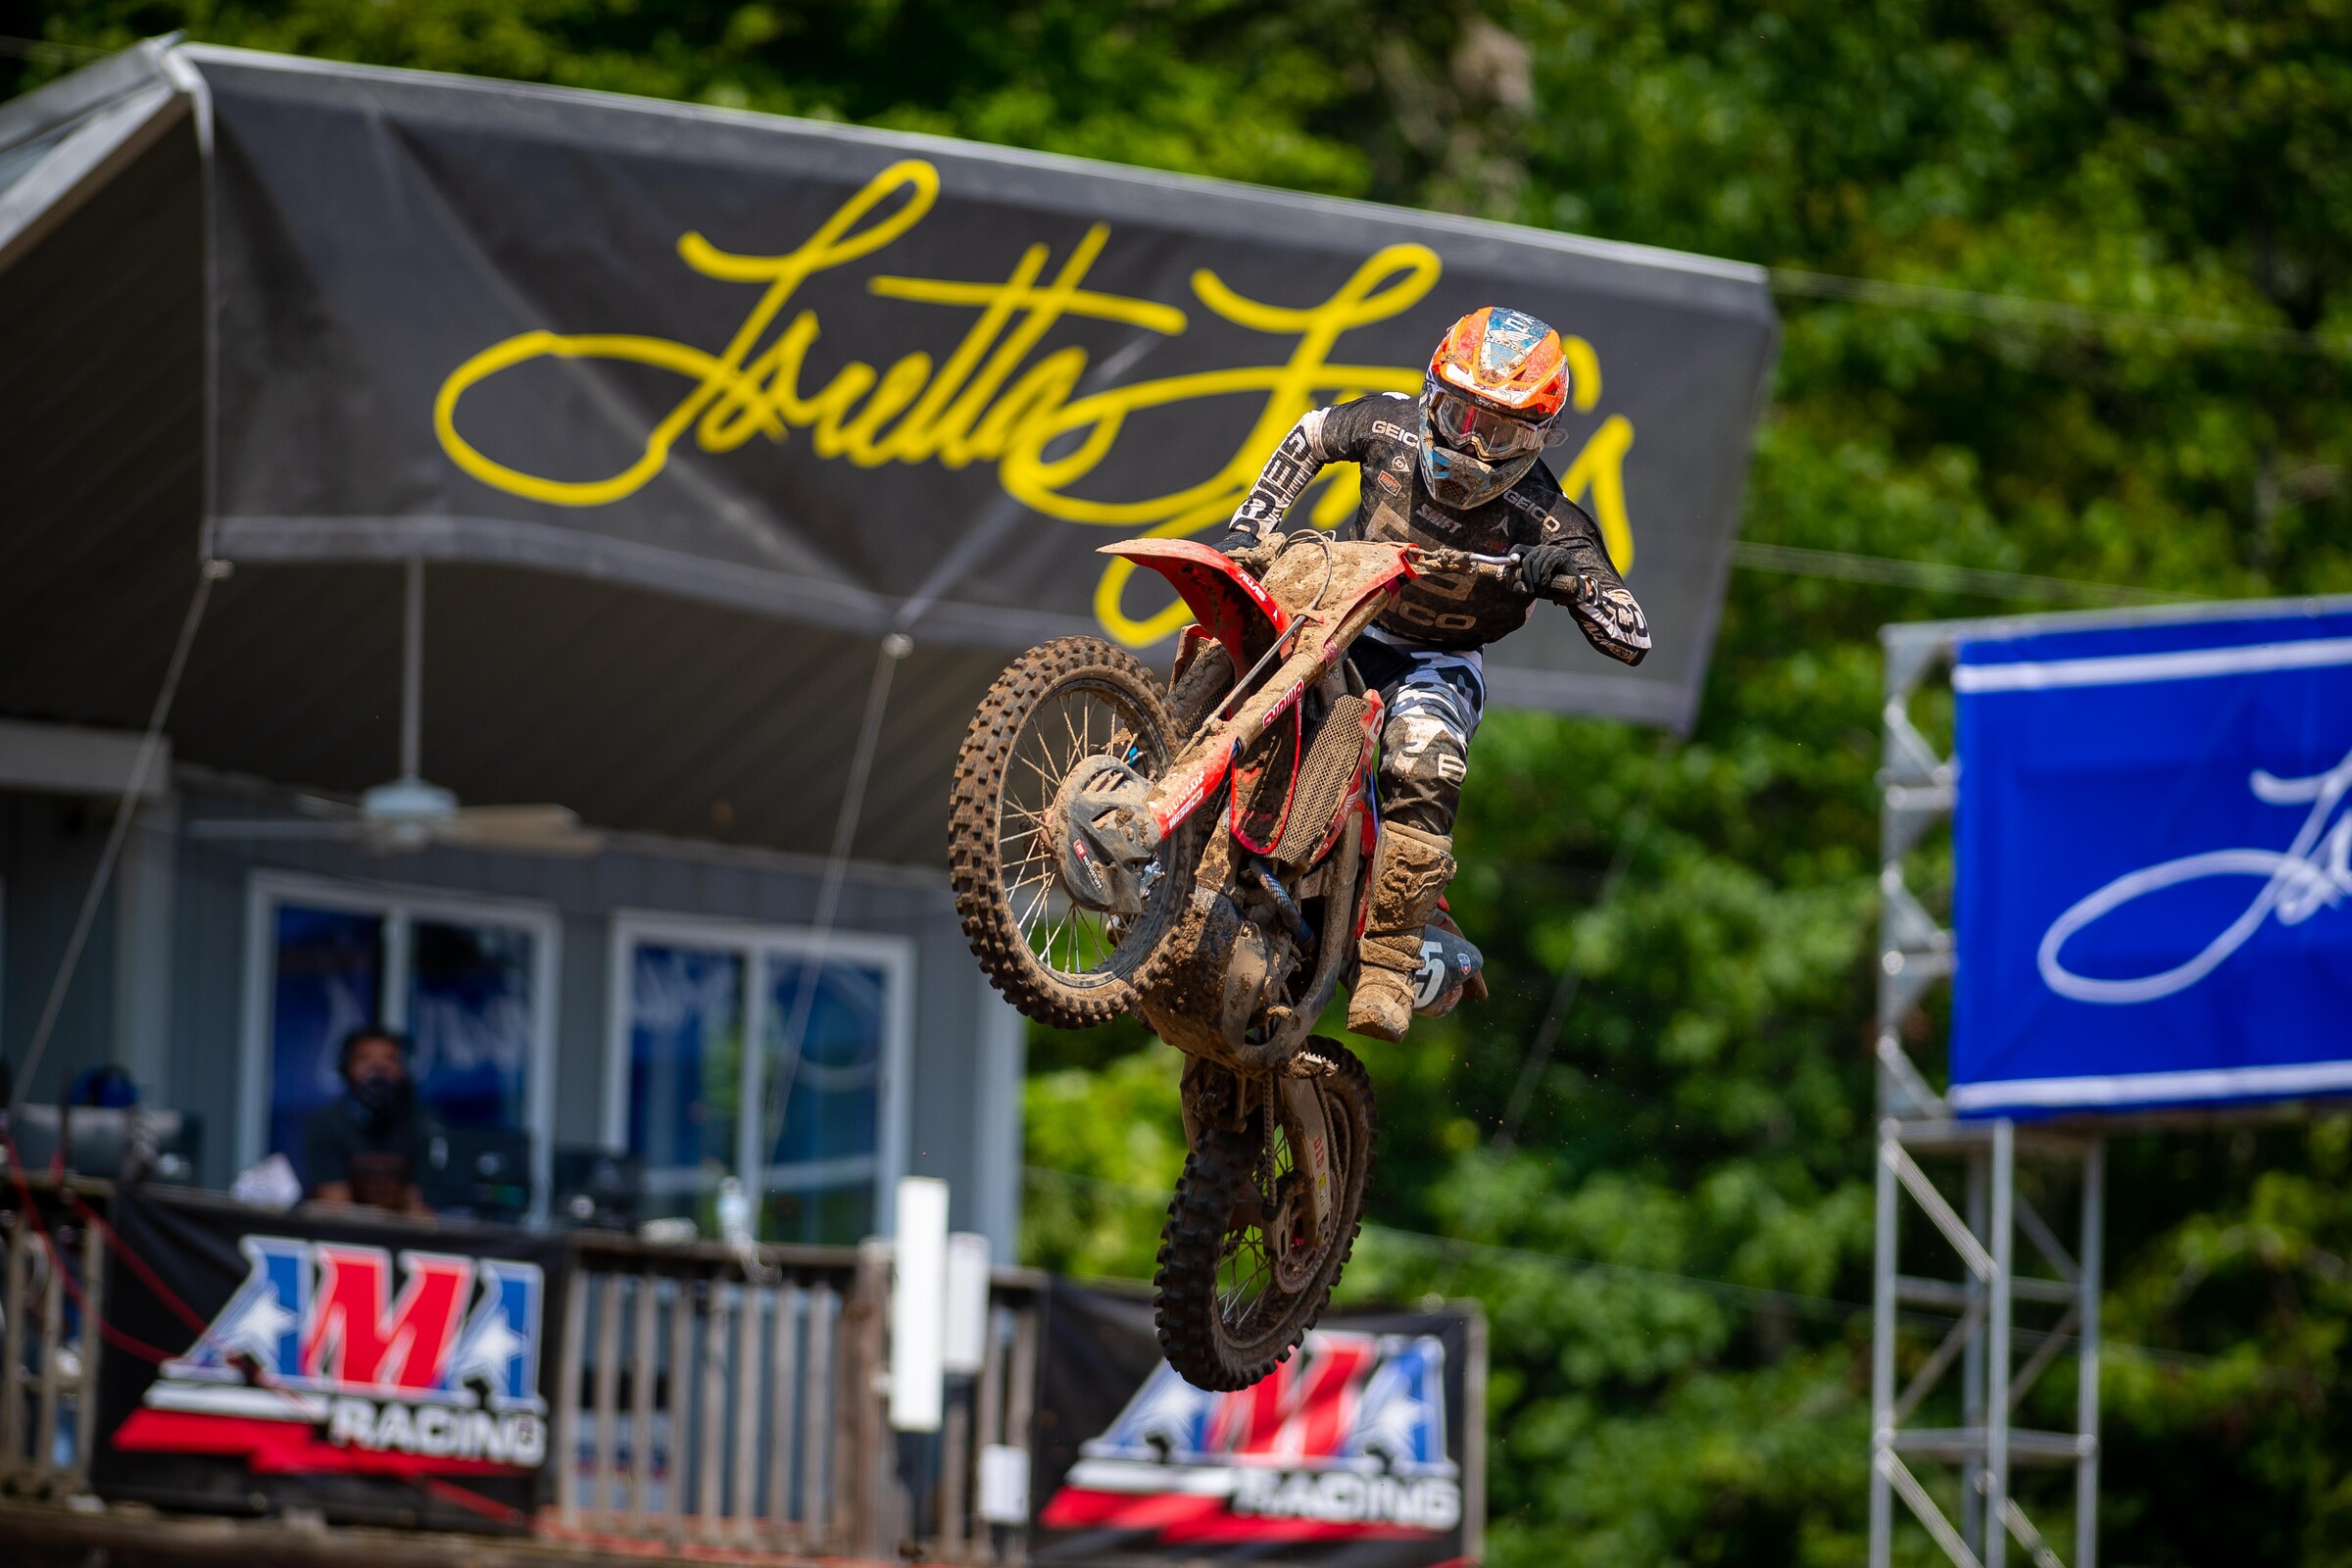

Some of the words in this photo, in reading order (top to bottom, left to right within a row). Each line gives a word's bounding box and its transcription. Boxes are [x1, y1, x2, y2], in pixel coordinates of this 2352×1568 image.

[1372, 419, 1419, 450] GEIC
[1416, 503, 1462, 534] SHIFT
[1503, 489, 1561, 533] GEICO
[1164, 770, 1205, 818] DUNLOP
[1082, 855, 1103, 889] MOTOSTUFF
[159, 1234, 548, 1415] AMA
[330, 1396, 547, 1467] RACING
[1231, 1468, 1462, 1532] RACING
